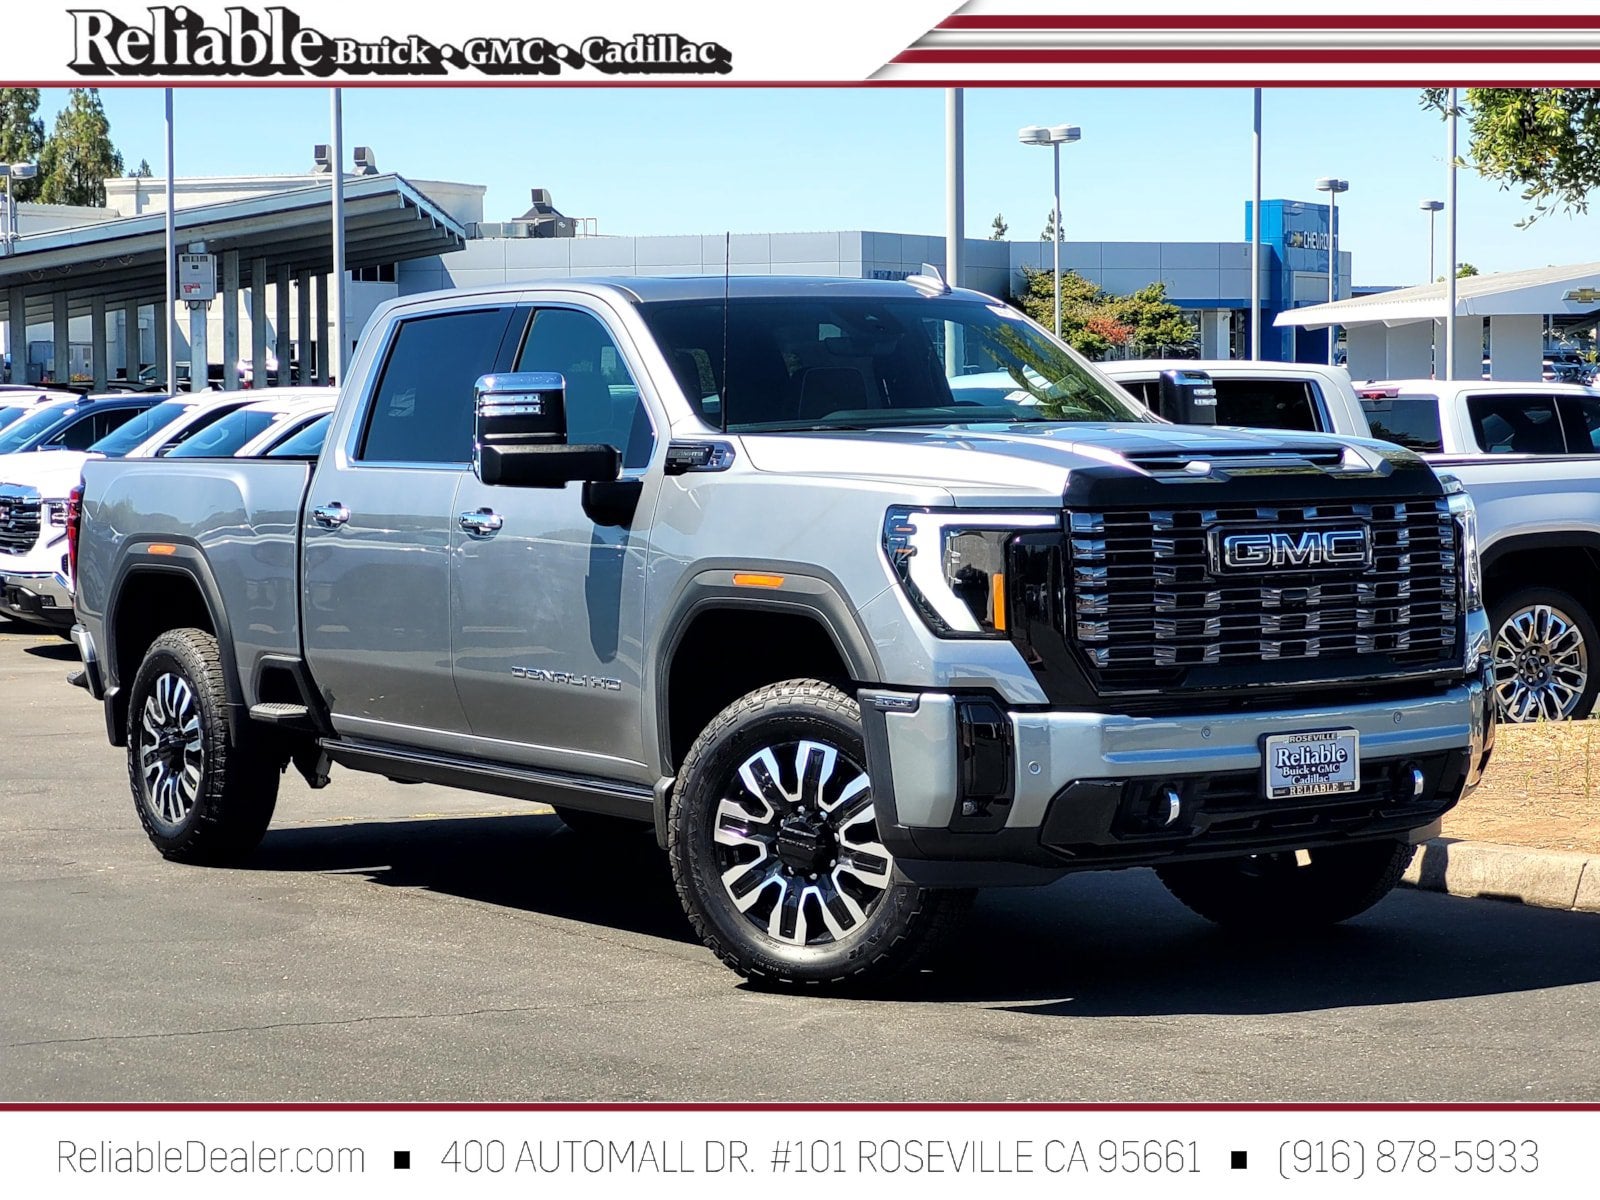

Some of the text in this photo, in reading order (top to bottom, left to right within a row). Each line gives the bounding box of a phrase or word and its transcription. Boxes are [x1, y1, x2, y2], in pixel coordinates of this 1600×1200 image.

[1303, 231, 1338, 250] CHEVROT
[1224, 530, 1364, 567] GMC
[511, 665, 622, 691] DENALI HD
[1289, 733, 1337, 743] ROSEVILLE
[1276, 744, 1347, 768] Reliable
[1282, 763, 1340, 777] Buick GMC
[1291, 774, 1329, 786] Cadillac
[1289, 782, 1339, 796] RELIABLE
